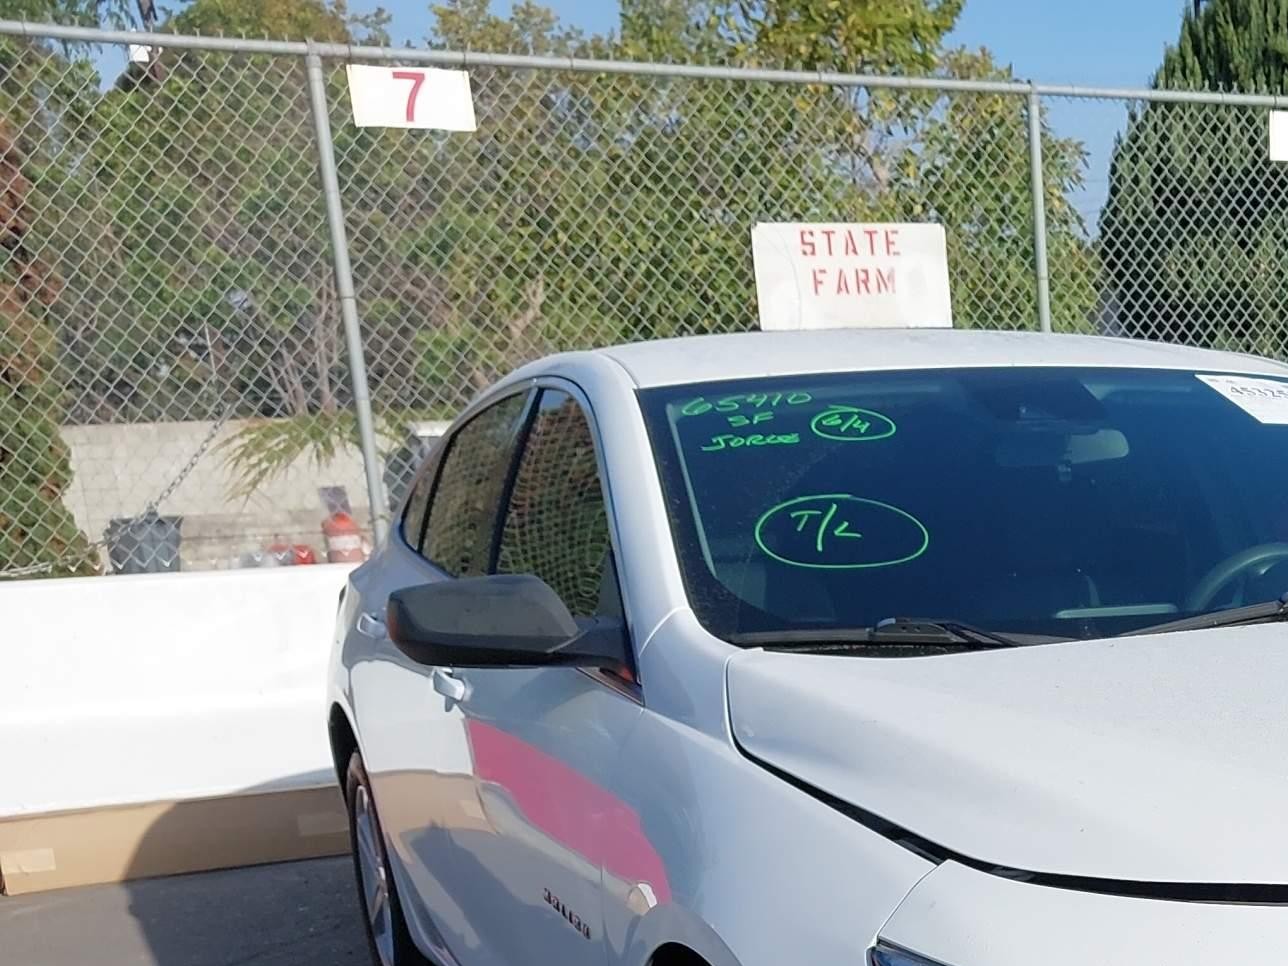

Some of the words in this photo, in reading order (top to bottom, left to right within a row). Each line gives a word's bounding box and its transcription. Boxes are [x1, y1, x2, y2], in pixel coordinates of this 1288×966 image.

[392, 71, 425, 123] 7
[799, 229, 901, 256] STATE
[812, 267, 896, 296] FARM
